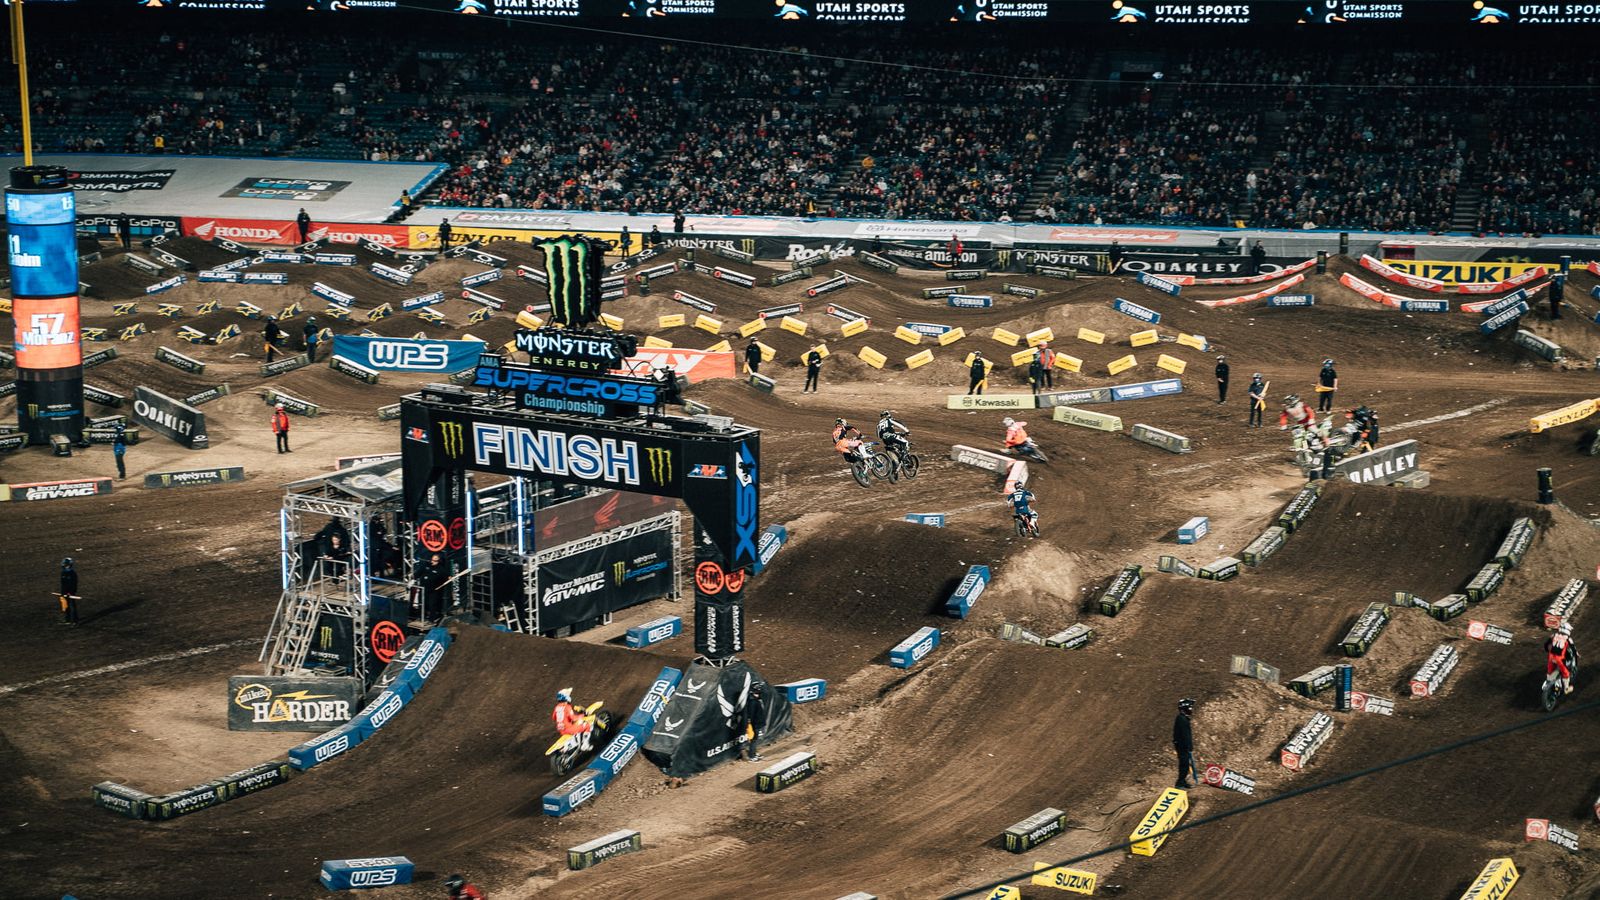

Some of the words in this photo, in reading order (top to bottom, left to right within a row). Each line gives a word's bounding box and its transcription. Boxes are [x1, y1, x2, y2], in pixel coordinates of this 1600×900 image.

[816, 3, 850, 13] UTAH
[856, 3, 905, 13] SPORTS
[1155, 5, 1191, 15] UTAH
[1197, 5, 1249, 15] SPORTS
[1519, 5, 1558, 15] UTAH
[259, 178, 332, 186] GoPro
[129, 218, 176, 228] GoPro
[214, 226, 282, 239] HONDA
[328, 232, 397, 245] HONDA
[666, 237, 736, 250] MONSTER
[925, 250, 977, 263] amaon
[1154, 261, 1242, 272] OAKLEY
[31, 313, 65, 335] 57
[368, 340, 449, 369] WPS
[516, 332, 615, 359] MONSTER
[480, 357, 500, 368] AMA
[531, 356, 600, 371] ENERGY
[475, 367, 658, 406] SUPERCROSS
[524, 393, 606, 417] Championship
[975, 398, 1020, 407] Kawasaki
[149, 406, 193, 437] OAKLEY
[1071, 414, 1104, 428] Kawasaki
[472, 421, 641, 486] FINISH
[173, 471, 218, 481] MONSTER
[1349, 452, 1416, 484] OAKLEY
[376, 632, 400, 651] RM
[648, 623, 673, 643] WPS
[418, 643, 444, 679] WPS
[796, 681, 820, 701] WPS
[252, 700, 352, 723] HARDER
[370, 695, 403, 728] WPS
[315, 735, 349, 762] WPS
[238, 770, 279, 788] MONSTER
[781, 762, 810, 781] MONSTER
[101, 794, 130, 809] MONSTER
[173, 791, 215, 809] MONSTER
[569, 780, 596, 807] WPS
[1138, 790, 1179, 837] SUZUKI
[1029, 820, 1059, 840] MONSTER
[594, 839, 632, 858] MONSTER
[350, 868, 398, 886] WPS
[1055, 872, 1093, 890] SUZUKI
